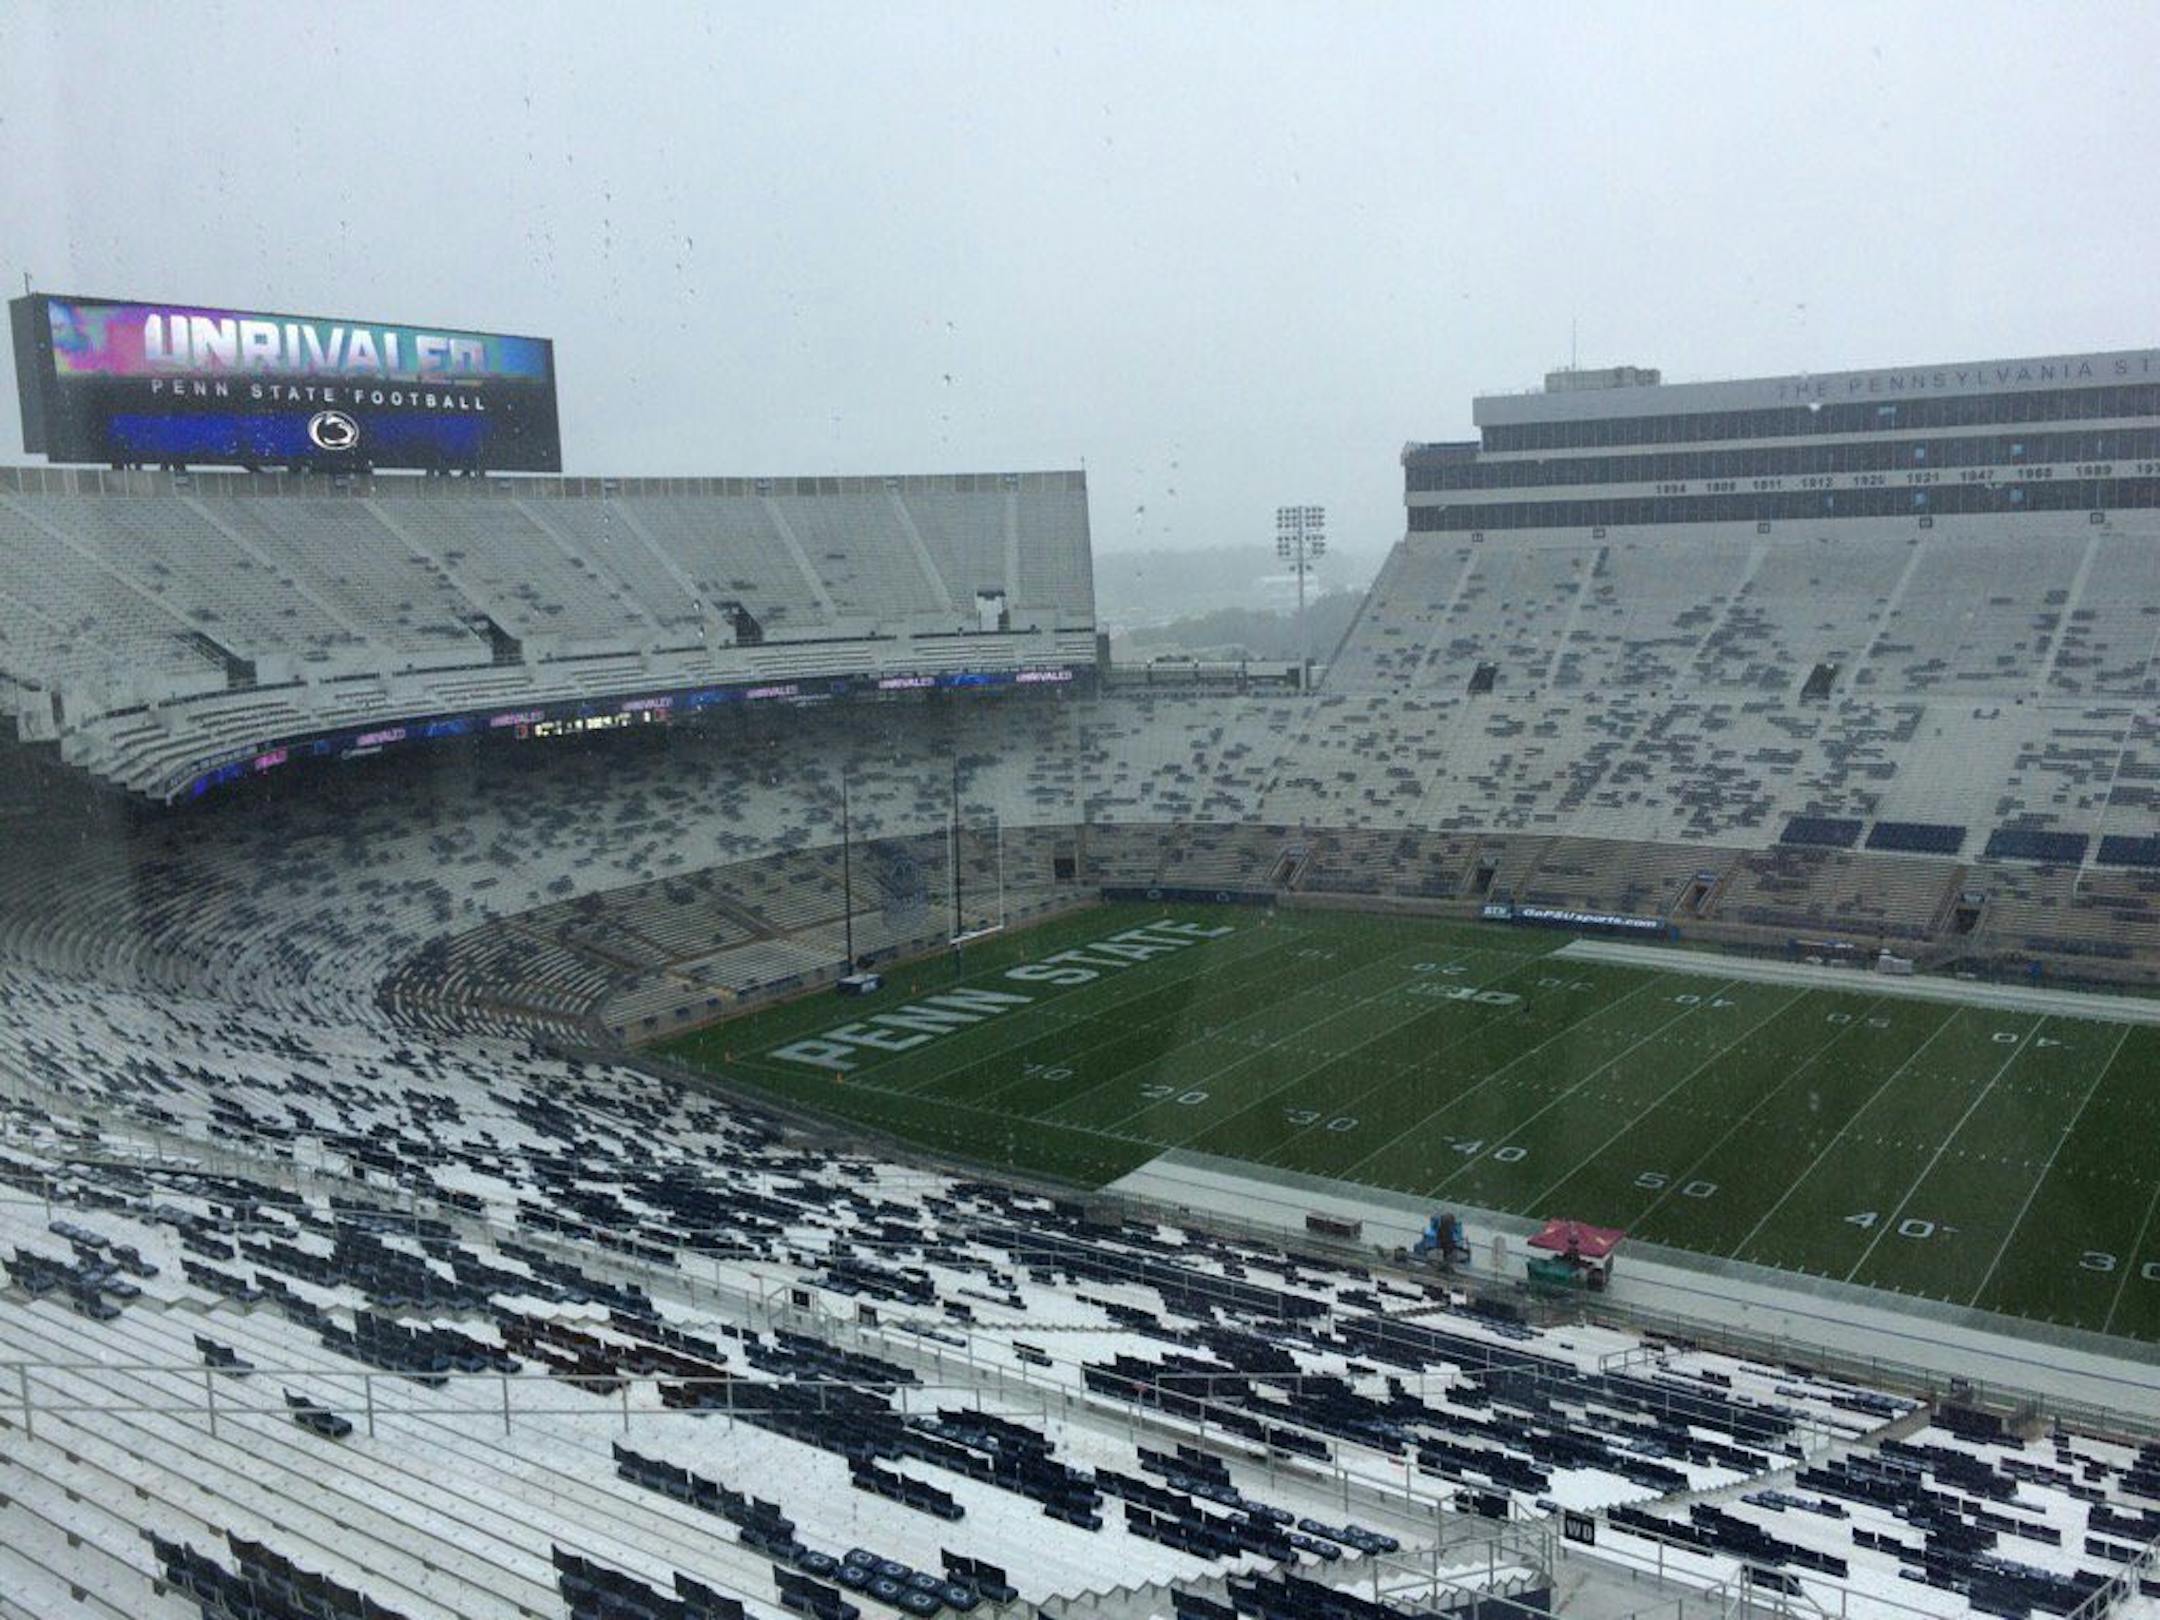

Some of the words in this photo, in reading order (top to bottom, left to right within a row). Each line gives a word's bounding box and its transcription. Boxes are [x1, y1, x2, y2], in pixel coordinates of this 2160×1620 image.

[145, 313, 487, 384] UNRIVALED
[151, 378, 229, 397] PENN
[251, 383, 335, 402] STATE
[354, 388, 485, 411] FOOTBALL
[1777, 381, 1827, 400] THE
[1849, 361, 2093, 393] PENNSYLVANIA
[1960, 469, 1993, 482] 1947
[1522, 907, 1657, 929] GoPSUsports.com
[766, 987, 1034, 1071] PENN
[1004, 919, 1236, 985] STATE
[1141, 1083, 1210, 1105] 20
[1284, 1107, 1360, 1133] 30
[1451, 1139, 1529, 1163] 40
[1633, 1171, 1719, 1199] 50
[1844, 1211, 1936, 1239] 40
